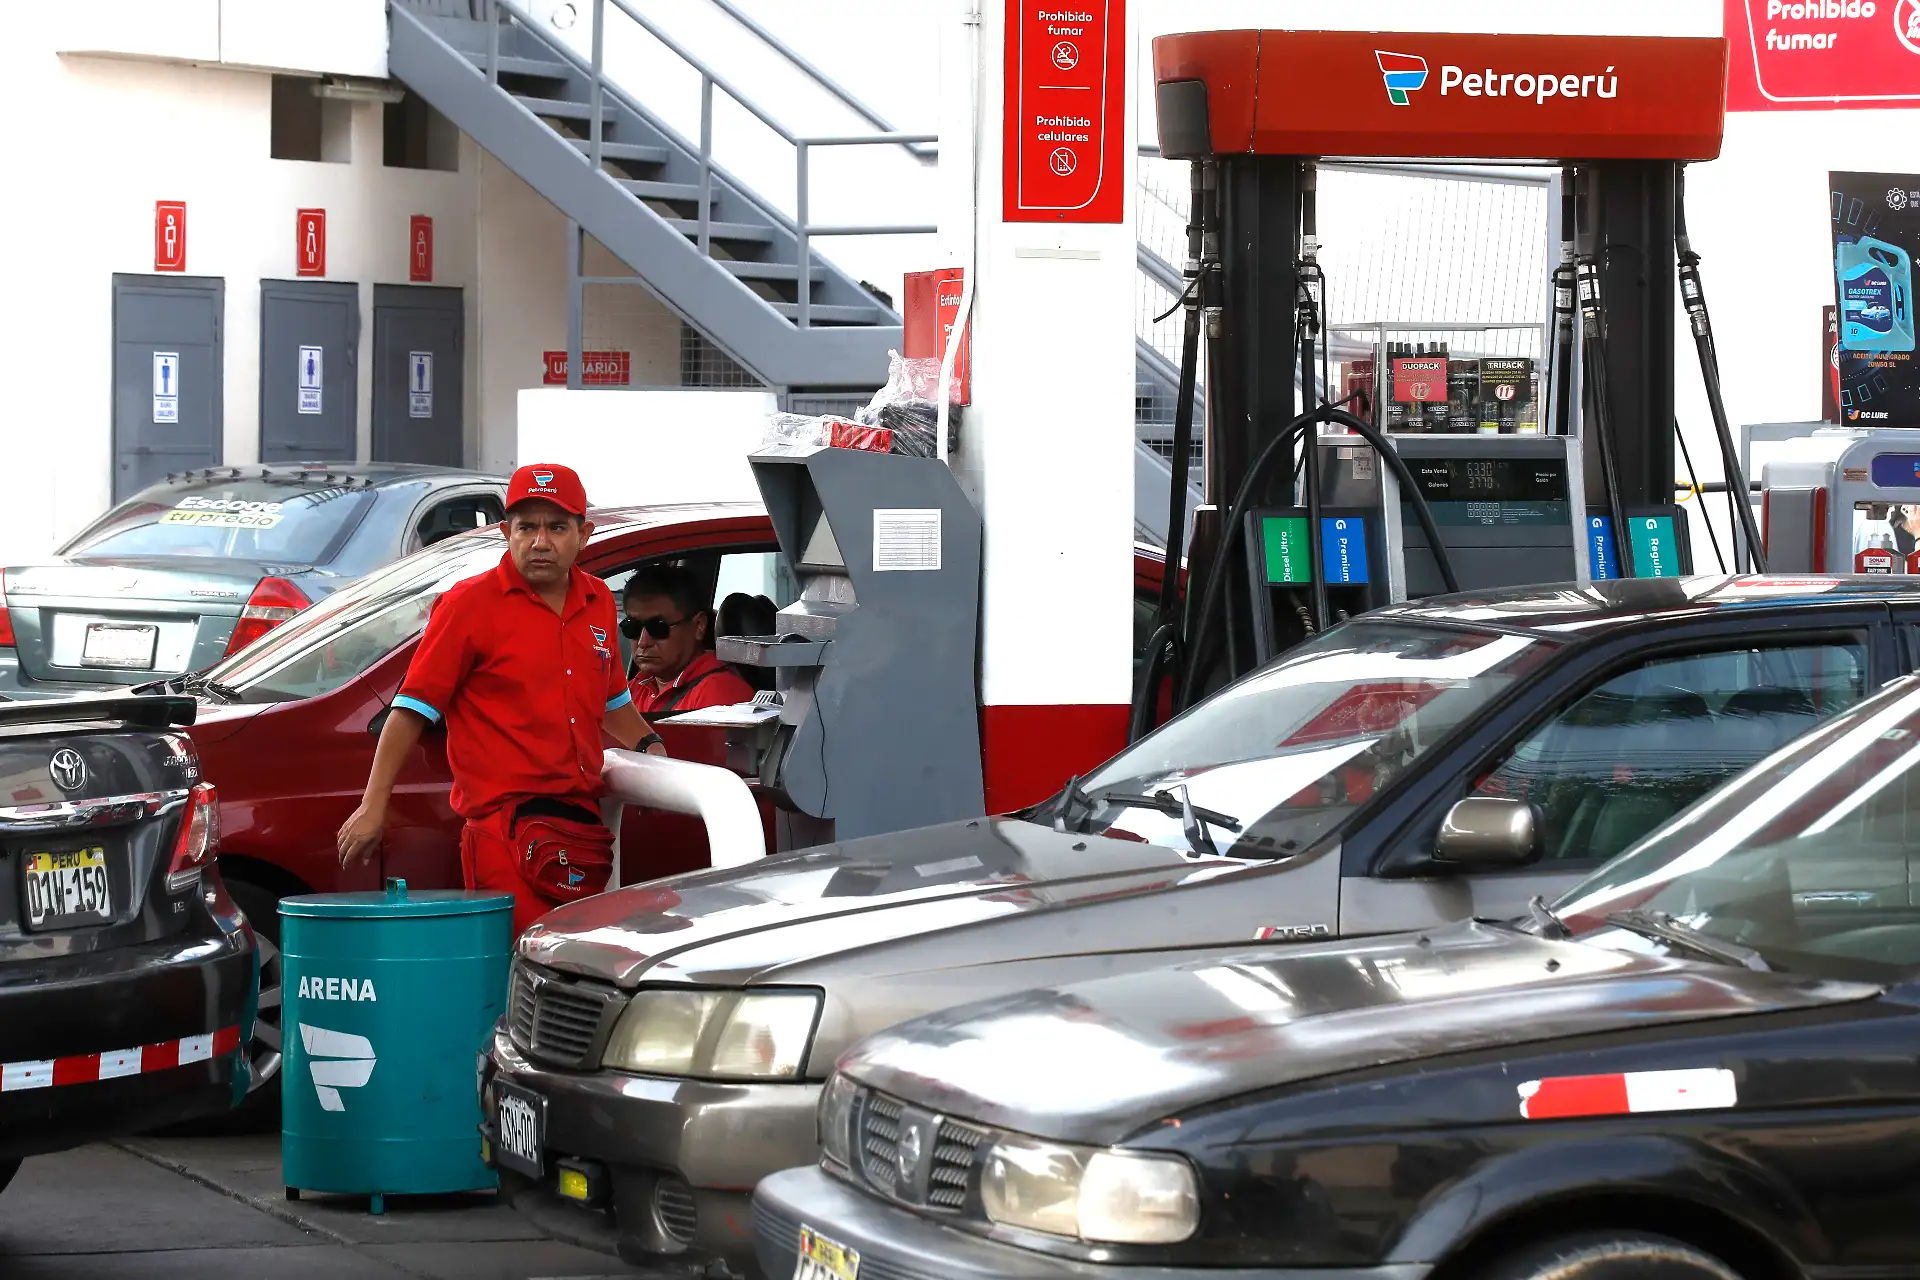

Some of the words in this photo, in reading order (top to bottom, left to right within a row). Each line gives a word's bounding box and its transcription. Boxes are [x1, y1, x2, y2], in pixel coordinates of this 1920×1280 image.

[1038, 10, 1093, 22] Prohibido
[1767, 0, 1876, 20] Prohibido
[1047, 25, 1083, 36] fumar
[1765, 28, 1837, 50] fumar
[1440, 65, 1618, 105] Petroperú
[1036, 115, 1091, 127] Prohibido
[1037, 131, 1089, 142] celulares
[1848, 288, 1881, 296] GASOTREX
[1402, 362, 1441, 370] DUOPACK
[1487, 361, 1524, 370] TRIPACK
[1860, 411, 1870, 419] DC
[1871, 411, 1888, 419] LUBE
[175, 496, 284, 514] Escoge
[169, 512, 195, 521] tu
[195, 513, 273, 526] precio
[1335, 519, 1347, 530] G
[1592, 517, 1603, 528] G
[1645, 518, 1658, 530] G
[1281, 531, 1289, 554] Ultra
[1340, 538, 1350, 582] Premium
[1650, 538, 1662, 578] Regula
[1283, 555, 1292, 582] Diesel
[51, 850, 80, 869] PERU
[28, 866, 107, 917] D1W-159
[298, 975, 377, 1002] ARENA
[500, 1104, 536, 1158] CSN-00
